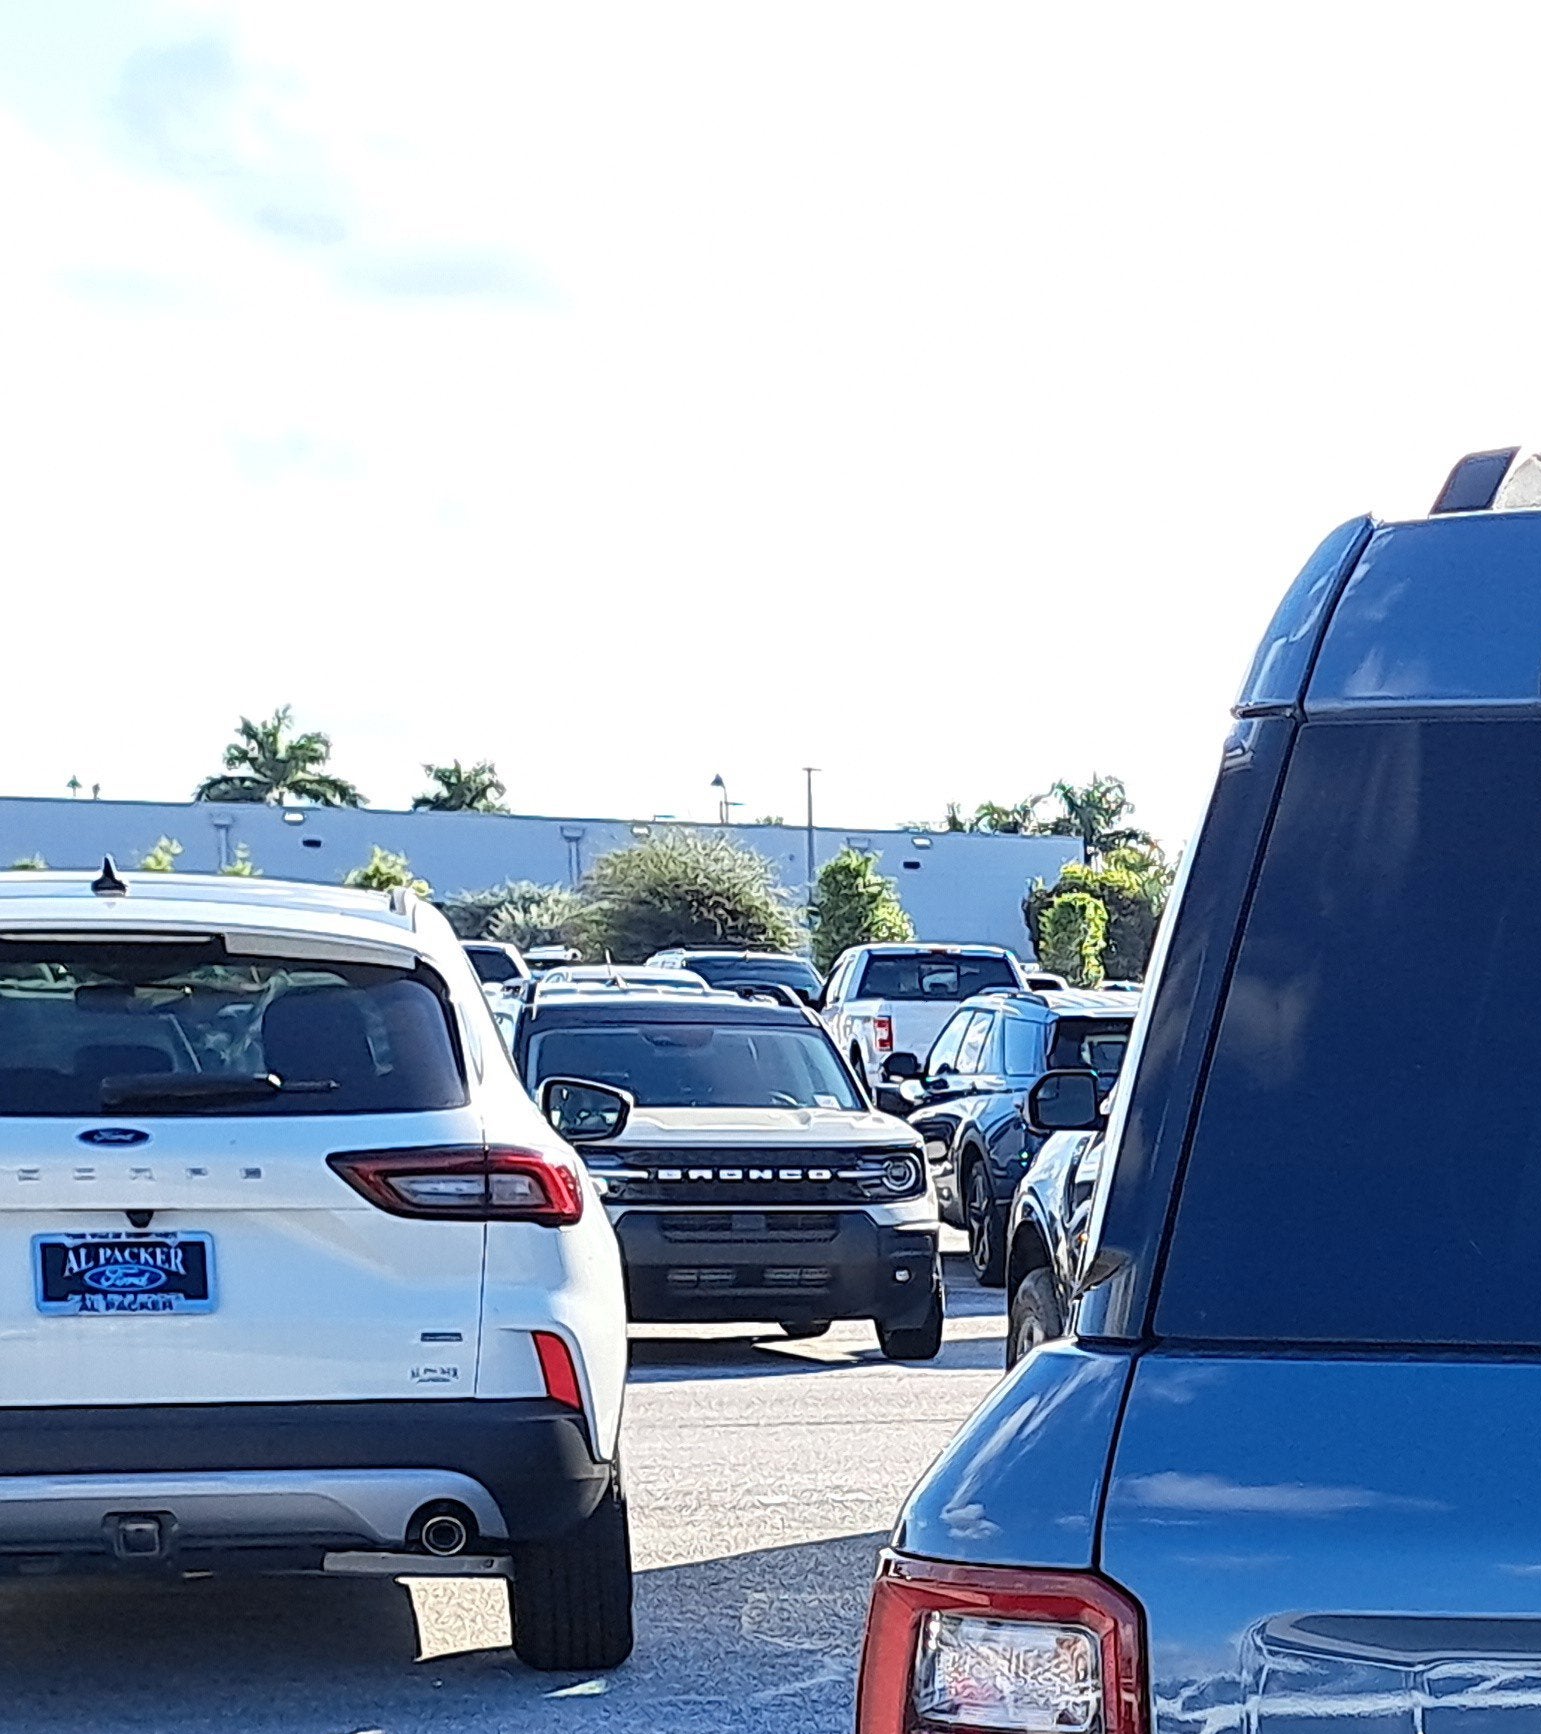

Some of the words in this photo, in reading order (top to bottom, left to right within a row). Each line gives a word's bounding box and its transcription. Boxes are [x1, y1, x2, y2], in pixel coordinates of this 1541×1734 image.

[657, 1168, 832, 1180] BRONCO
[63, 1247, 95, 1278] AL
[98, 1246, 187, 1276] PACKER
[100, 1266, 151, 1287] Ford
